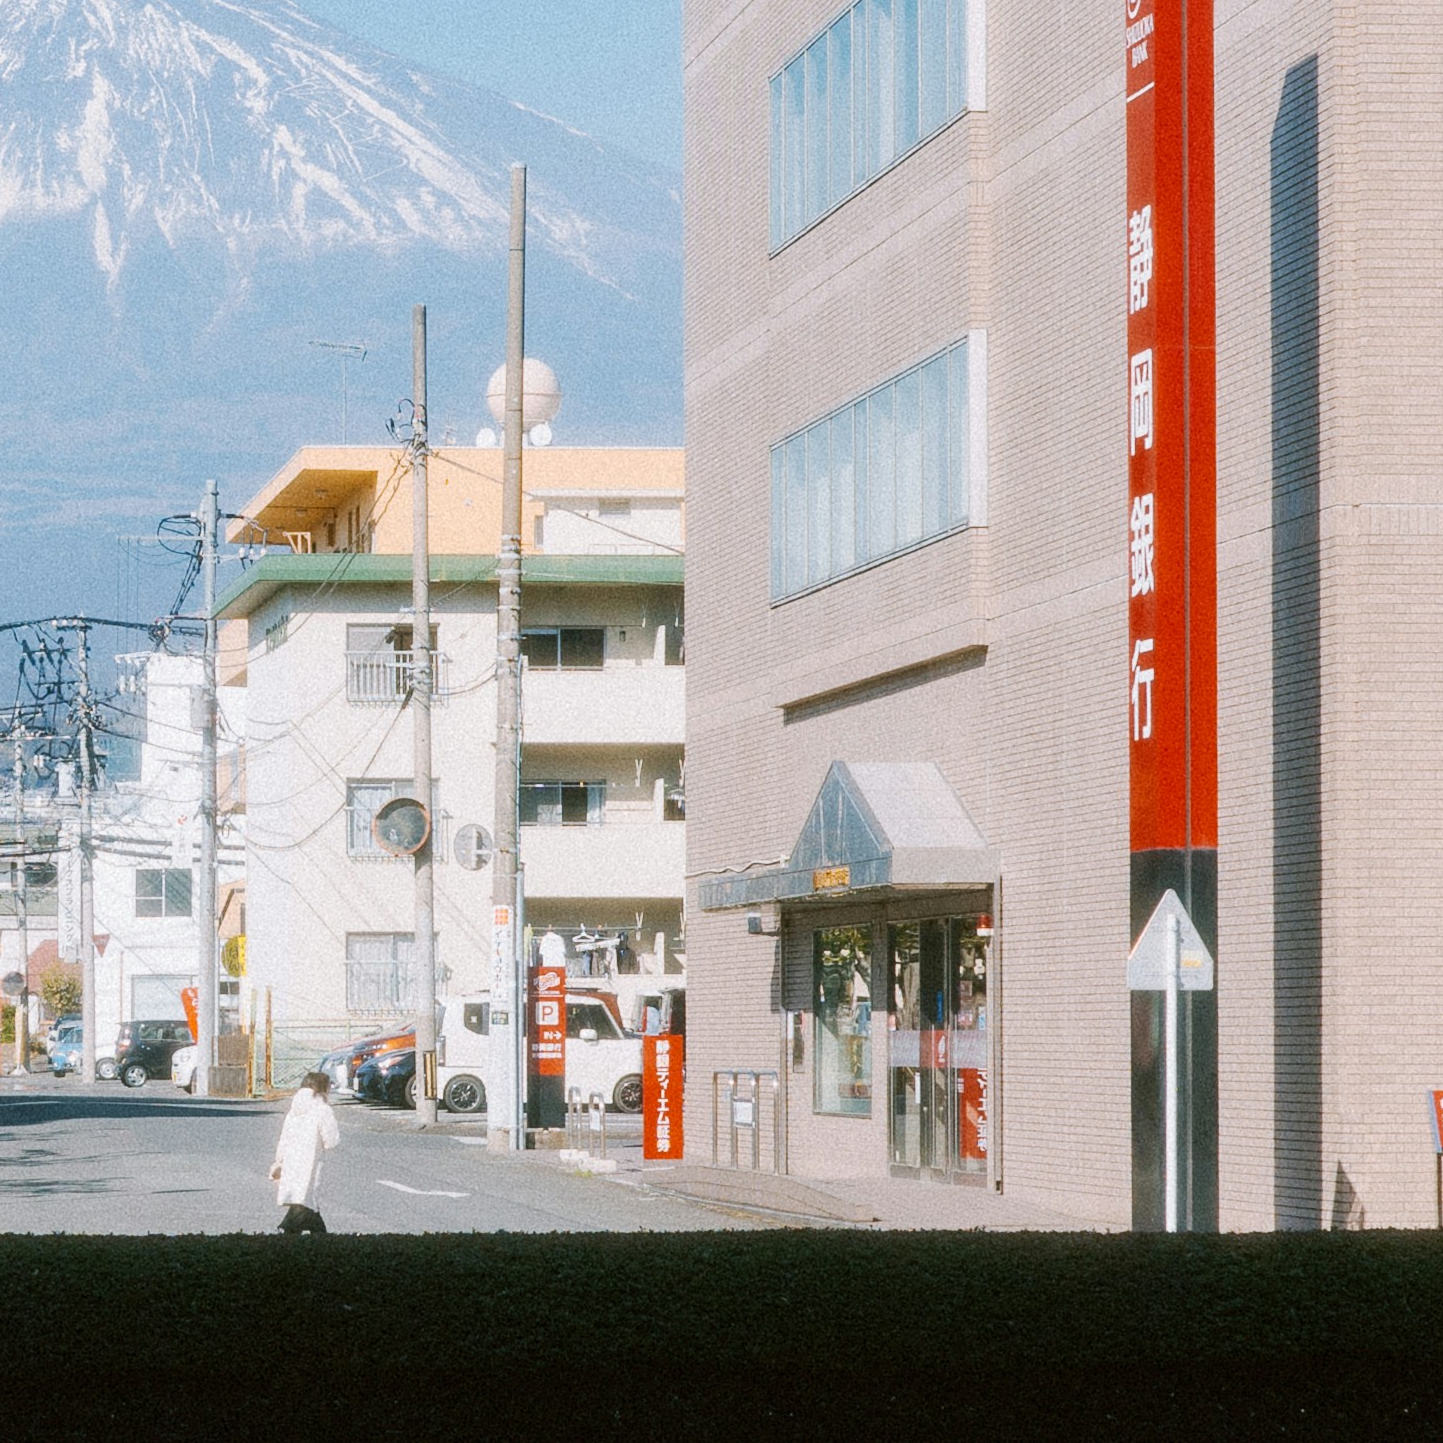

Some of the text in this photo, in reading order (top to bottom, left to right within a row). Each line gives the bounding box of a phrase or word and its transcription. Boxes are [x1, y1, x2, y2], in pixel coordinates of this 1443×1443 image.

[1131, 40, 1149, 68] BANK
[1128, 204, 1155, 742] 静岡銀行
[542, 1006, 554, 1022] P
[656, 1040, 671, 1152] 静銀ティーエム証券
